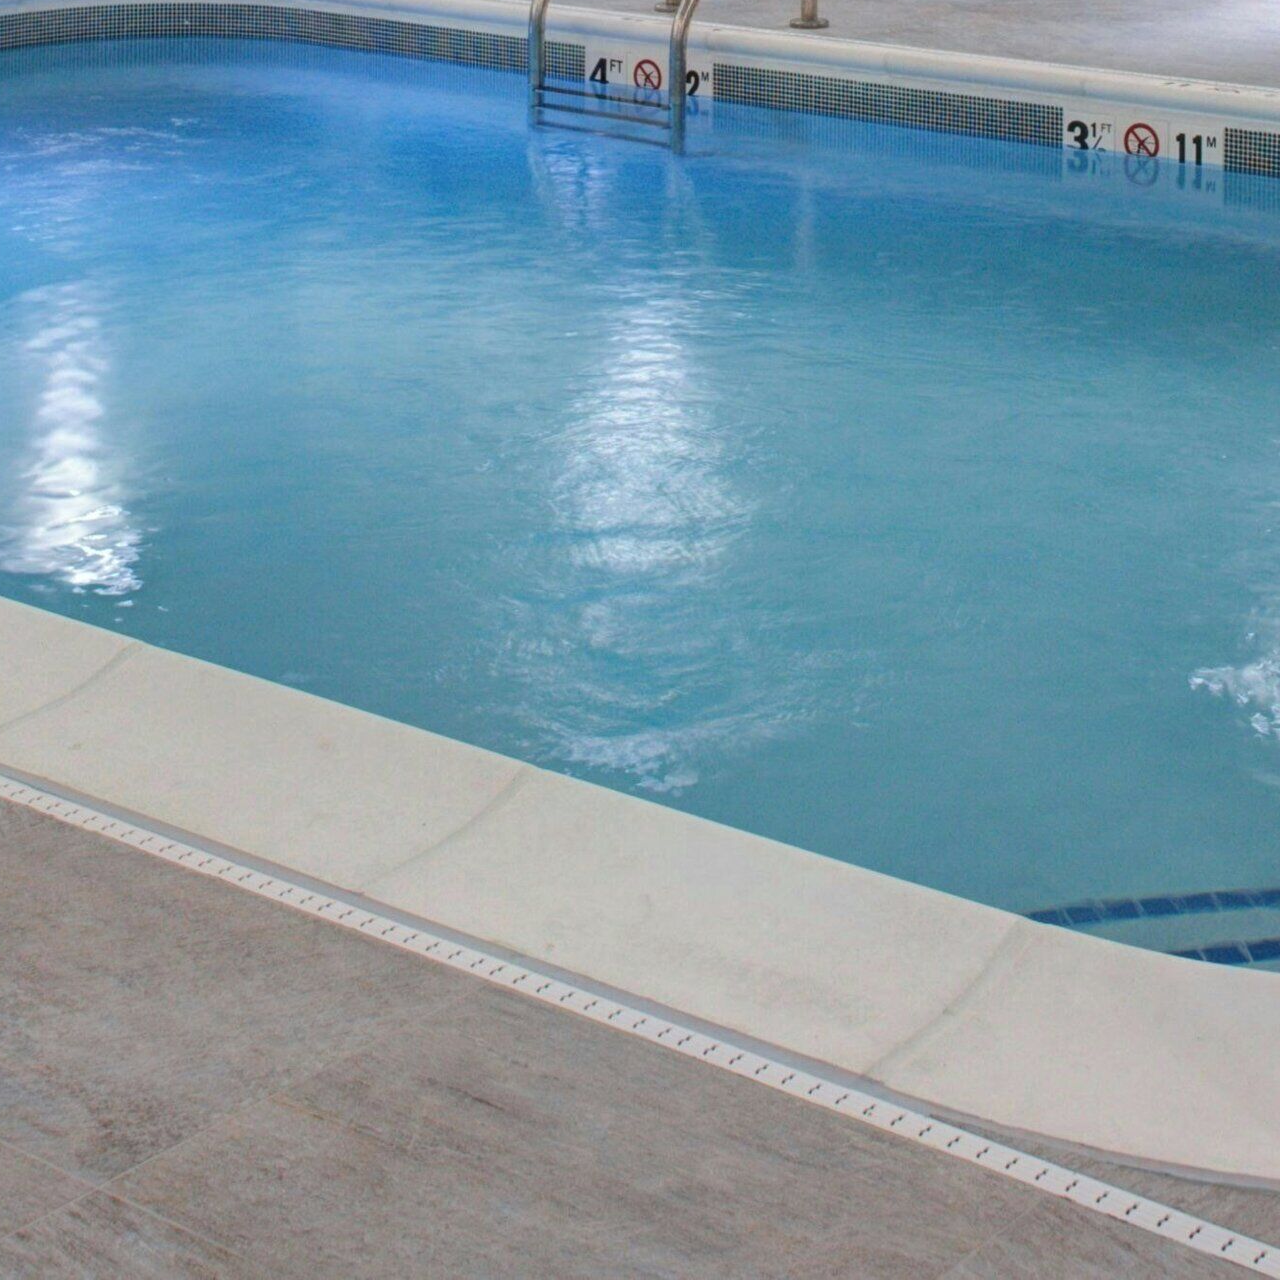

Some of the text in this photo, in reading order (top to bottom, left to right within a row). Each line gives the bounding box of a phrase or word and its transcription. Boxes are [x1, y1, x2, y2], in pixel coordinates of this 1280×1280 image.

[589, 58, 623, 84] 4 FT
[701, 72, 710, 82] M
[1100, 122, 1112, 133] FT
[1206, 136, 1217, 148] M
